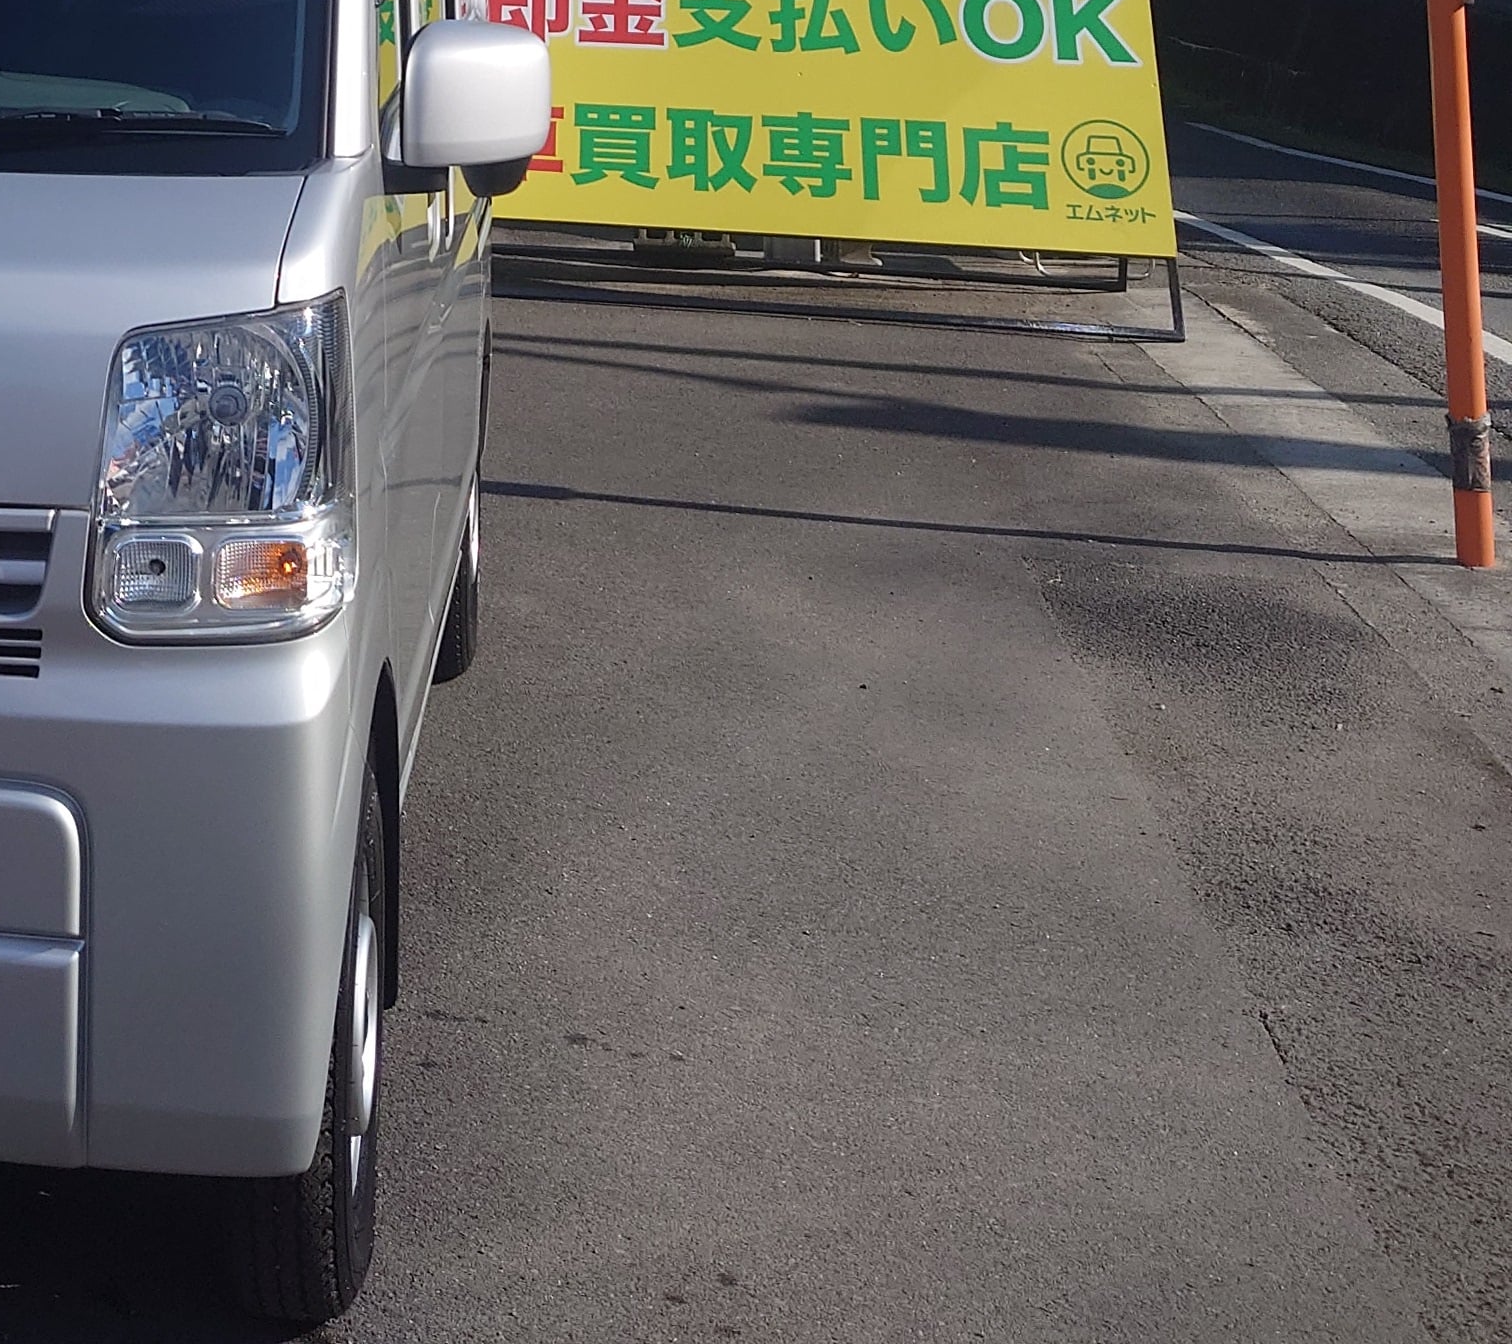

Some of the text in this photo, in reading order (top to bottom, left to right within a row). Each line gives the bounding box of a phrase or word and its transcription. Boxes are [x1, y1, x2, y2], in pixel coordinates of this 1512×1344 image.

[1065, 204, 1157, 225] エムネット
